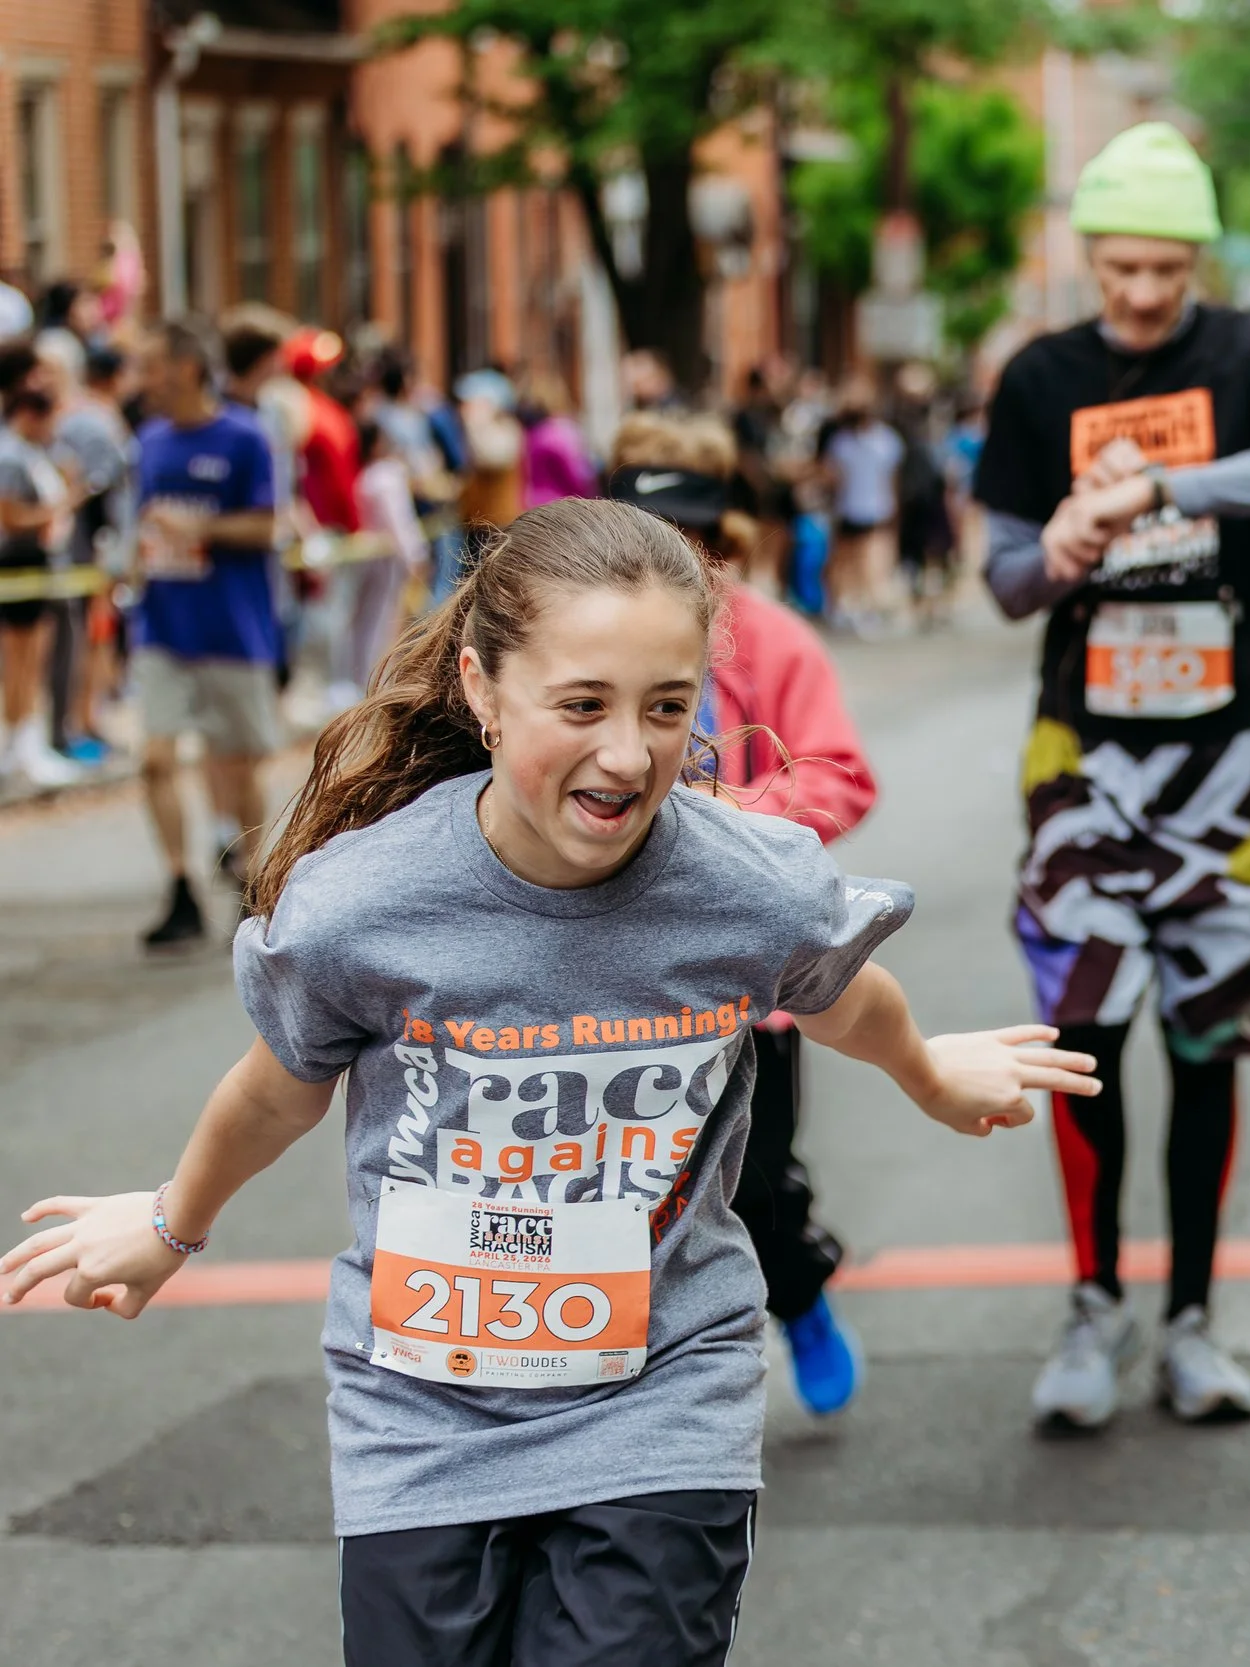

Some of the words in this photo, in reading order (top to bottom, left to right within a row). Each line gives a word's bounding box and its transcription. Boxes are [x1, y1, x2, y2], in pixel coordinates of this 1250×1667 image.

[443, 1015, 560, 1051] Years
[572, 995, 750, 1046] Running!
[451, 1121, 700, 1184] agains
[472, 1201, 483, 1209] 28
[486, 1203, 509, 1212] Years
[512, 1206, 554, 1216] Running!
[470, 1210, 481, 1249] ywca
[483, 1213, 553, 1237] race
[482, 1240, 552, 1256] RACISM
[484, 1232, 549, 1246] against
[469, 1259, 534, 1271] LANCASTER,
[537, 1263, 551, 1272] PA
[470, 1250, 500, 1260] APRIL
[503, 1253, 520, 1263] 25,
[523, 1255, 551, 1263] 2026
[401, 1269, 611, 1342] 2130
[392, 1344, 422, 1364] ywca
